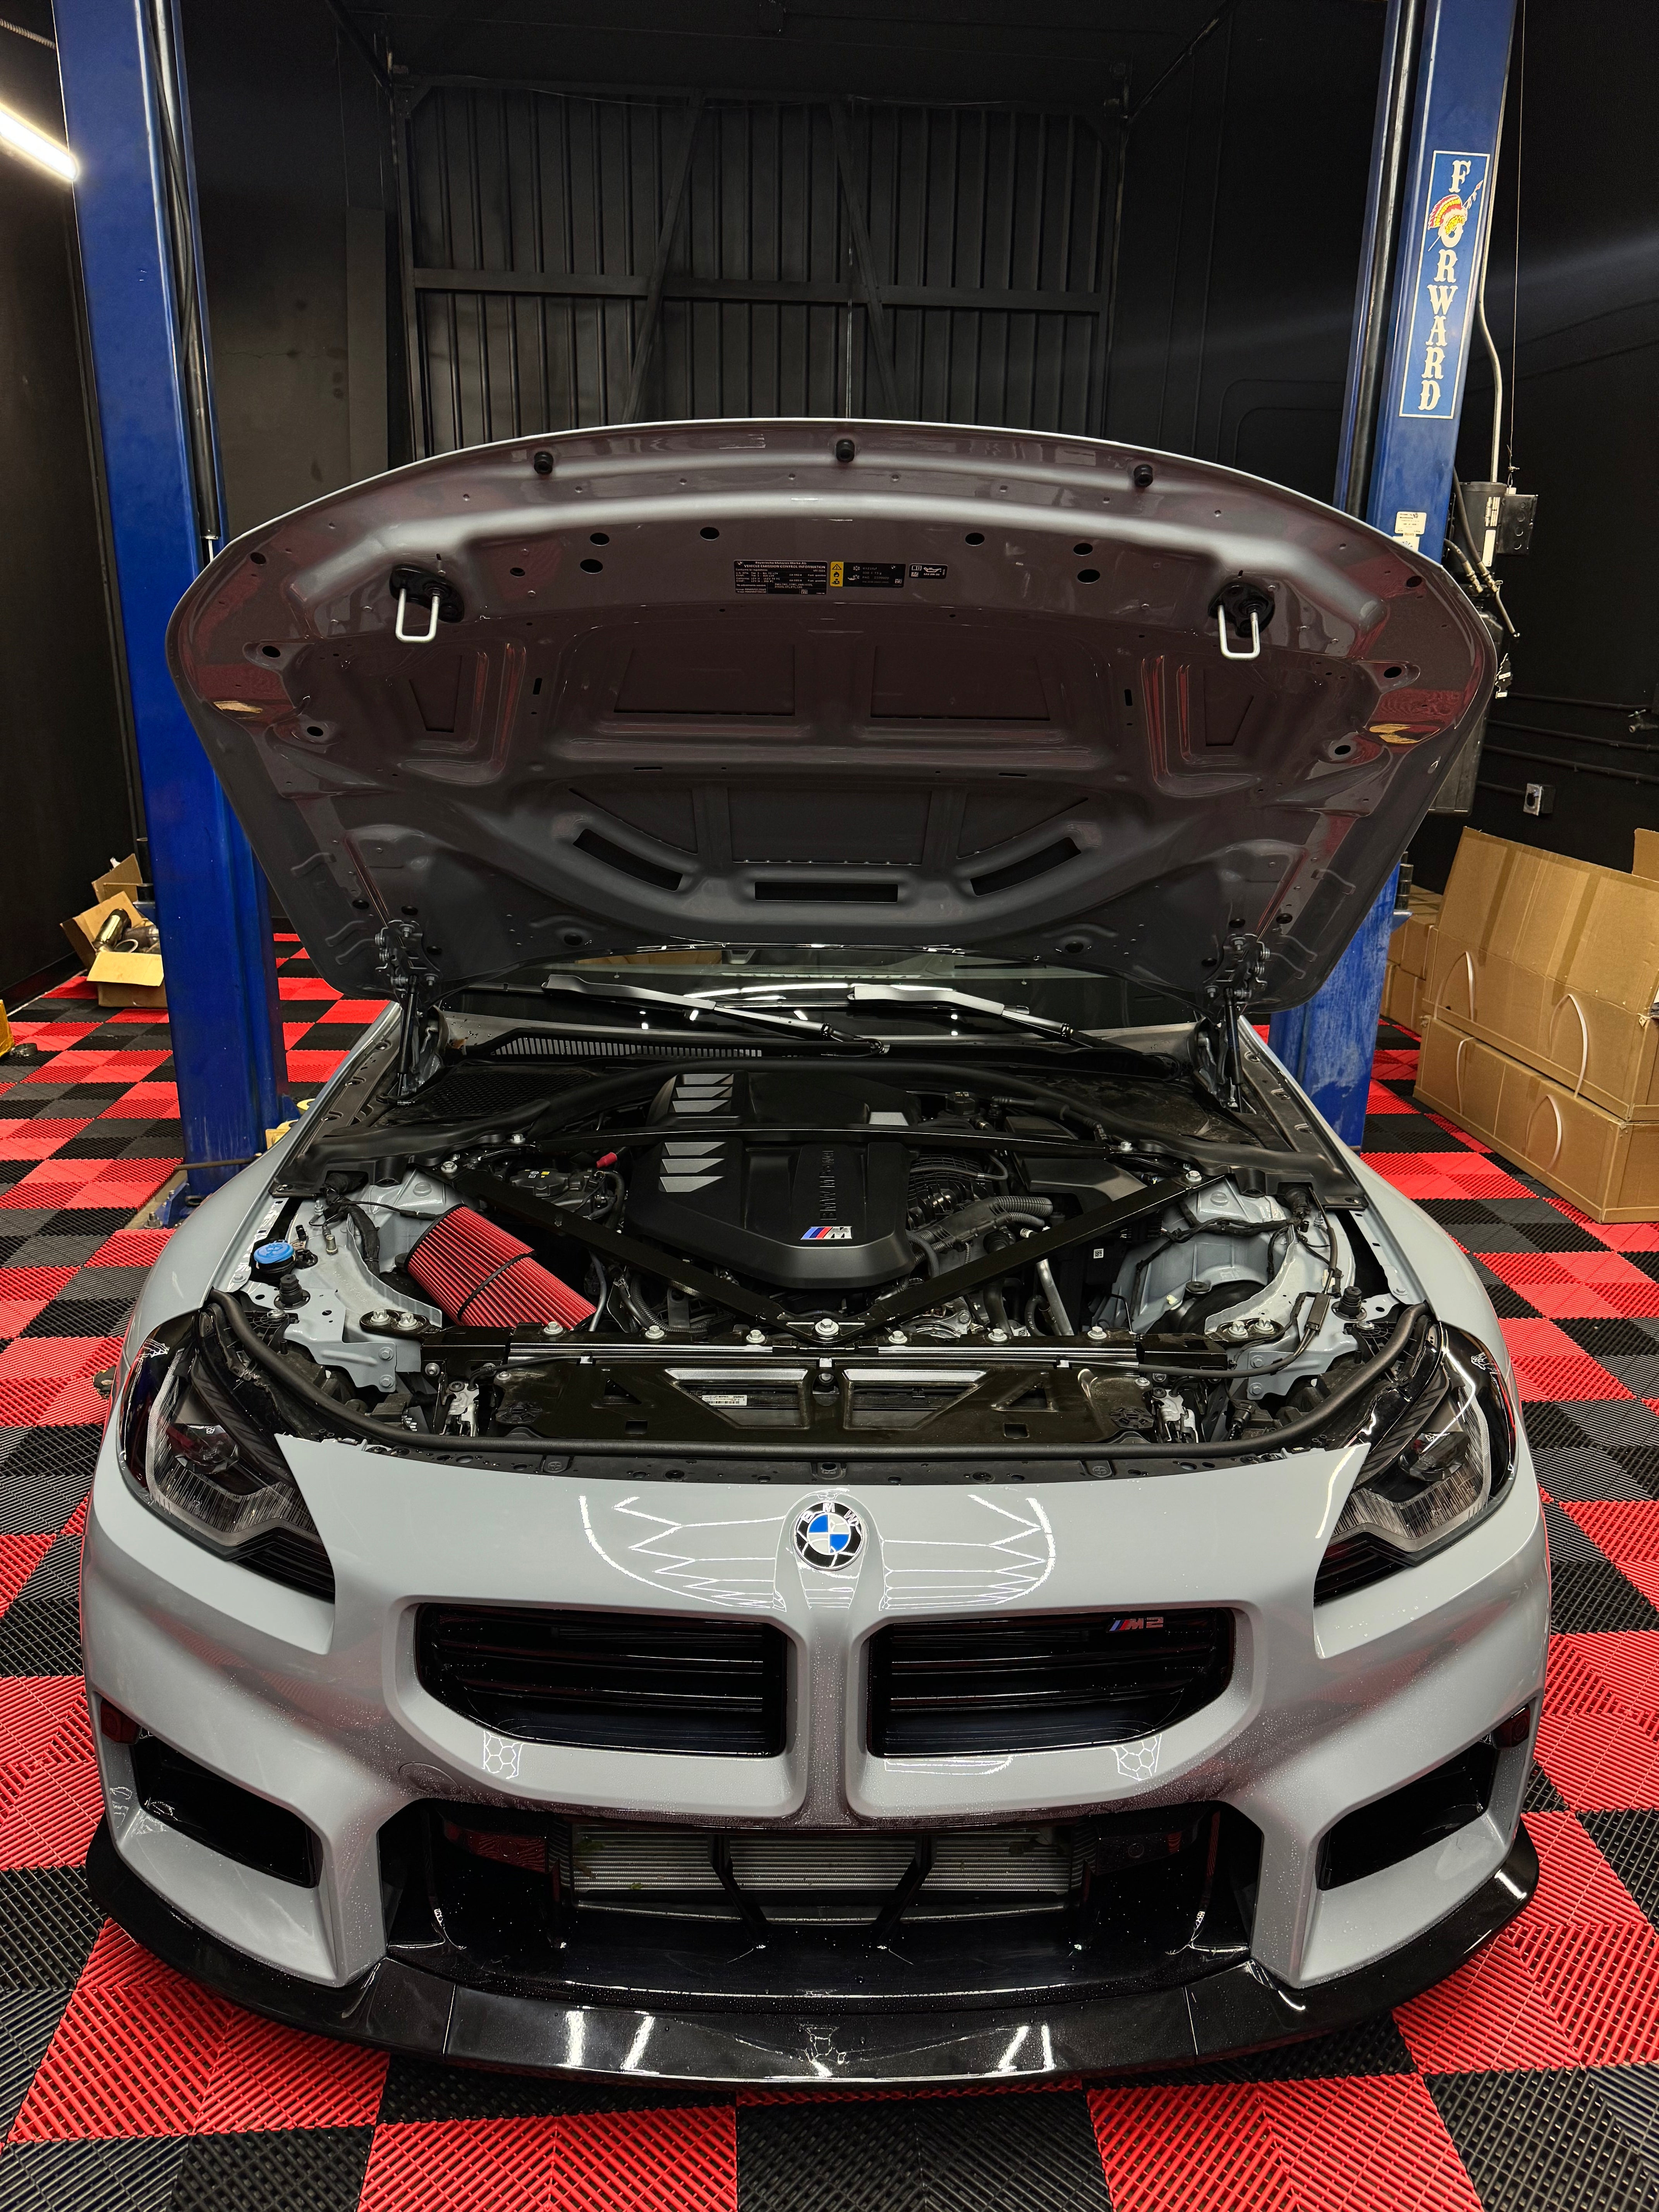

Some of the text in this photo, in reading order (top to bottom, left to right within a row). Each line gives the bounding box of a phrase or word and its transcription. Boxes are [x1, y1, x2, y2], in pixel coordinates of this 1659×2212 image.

[819, 1187, 837, 1220] BMW
[800, 1502, 859, 1527] BMW
[1124, 1616, 1164, 1630] M2
